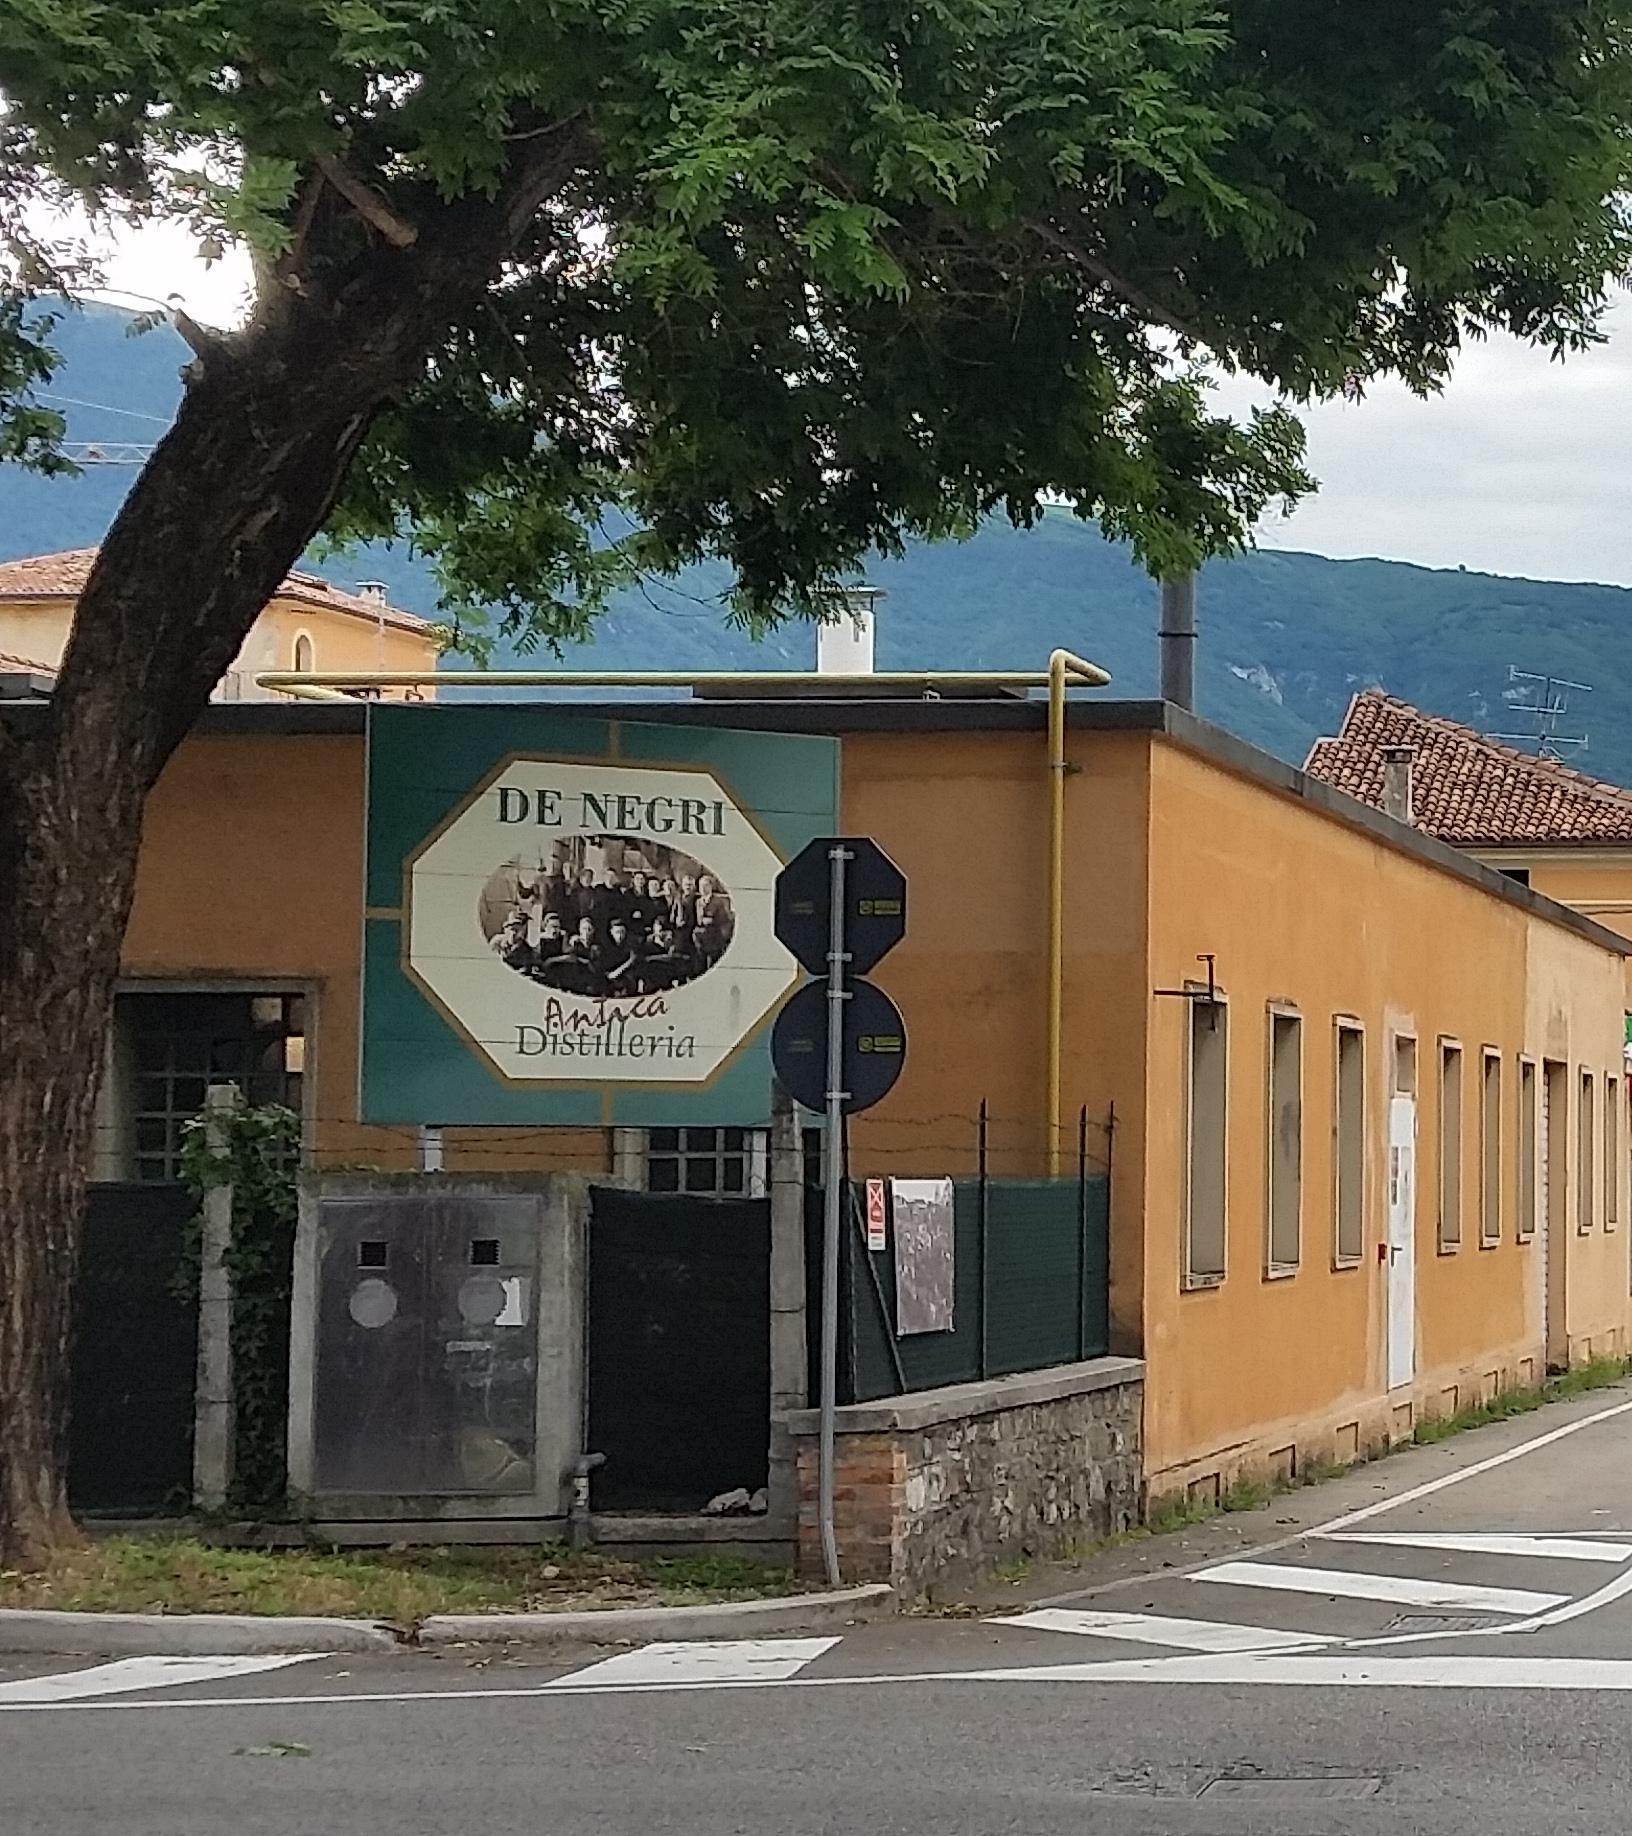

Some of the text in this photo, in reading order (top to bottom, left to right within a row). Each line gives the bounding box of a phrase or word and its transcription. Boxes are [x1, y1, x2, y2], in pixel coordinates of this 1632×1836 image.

[497, 786, 727, 836] DE NEGRI
[544, 996, 669, 1034] Antica
[515, 1020, 695, 1058] Distilleria
